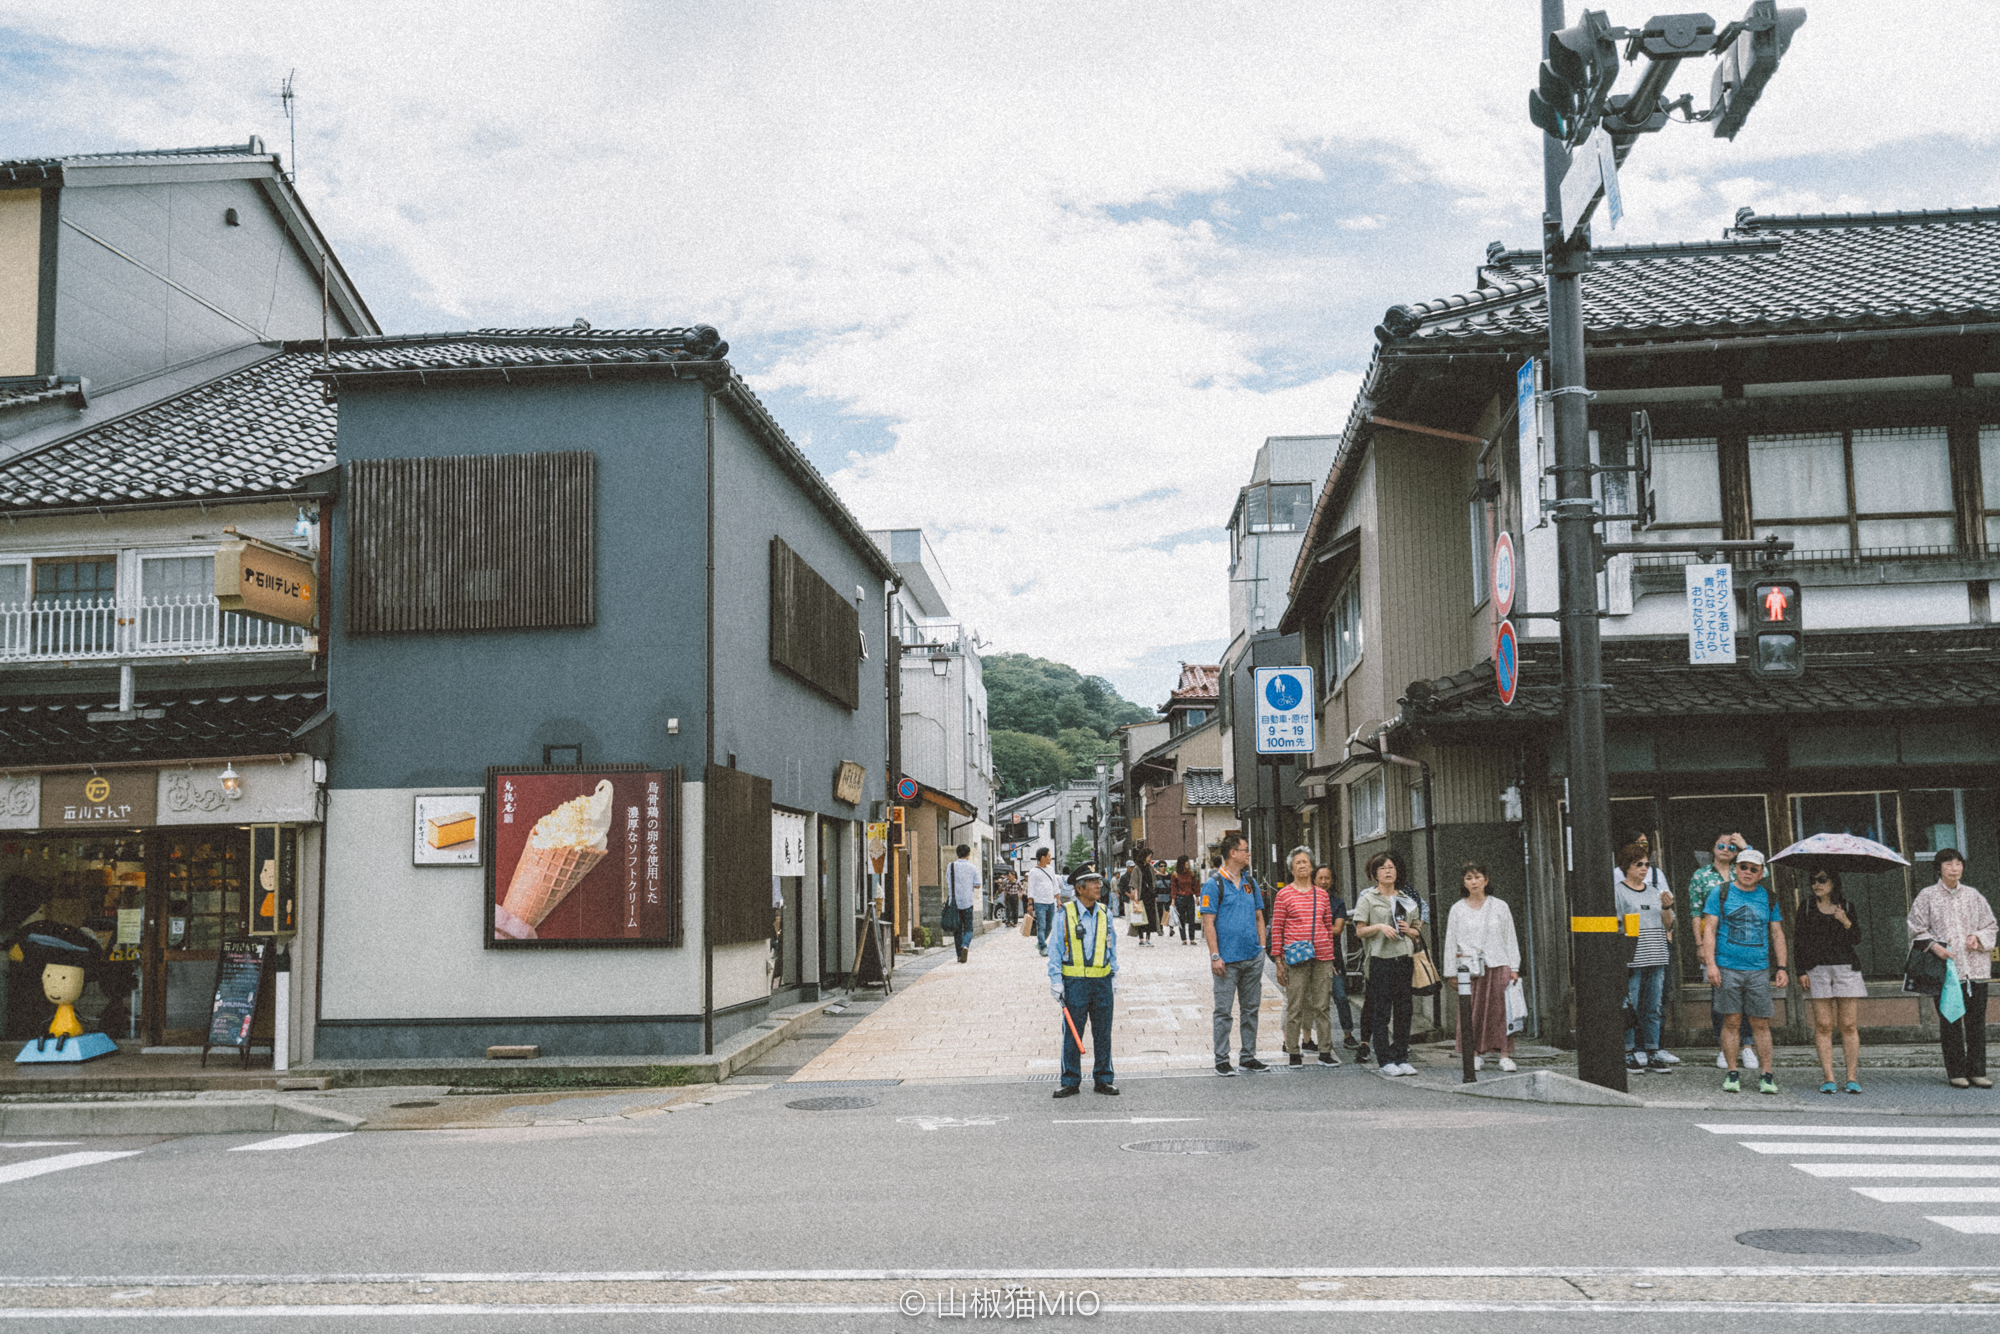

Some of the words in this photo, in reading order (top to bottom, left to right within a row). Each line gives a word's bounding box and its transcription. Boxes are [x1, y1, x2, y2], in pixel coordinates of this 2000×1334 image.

[255, 570, 301, 598] 石川テレビ
[1703, 577, 1718, 652] 青になってから
[1715, 567, 1731, 653] 押ボタンをおして
[1691, 586, 1706, 660] おわたり下さい
[1261, 714, 1309, 724] 自動車・原付
[63, 804, 131, 820] 石川さんや
[646, 781, 660, 904] 烏骨鶏の卵を使用した
[626, 806, 640, 928] 濃厚なソフトクリーム
